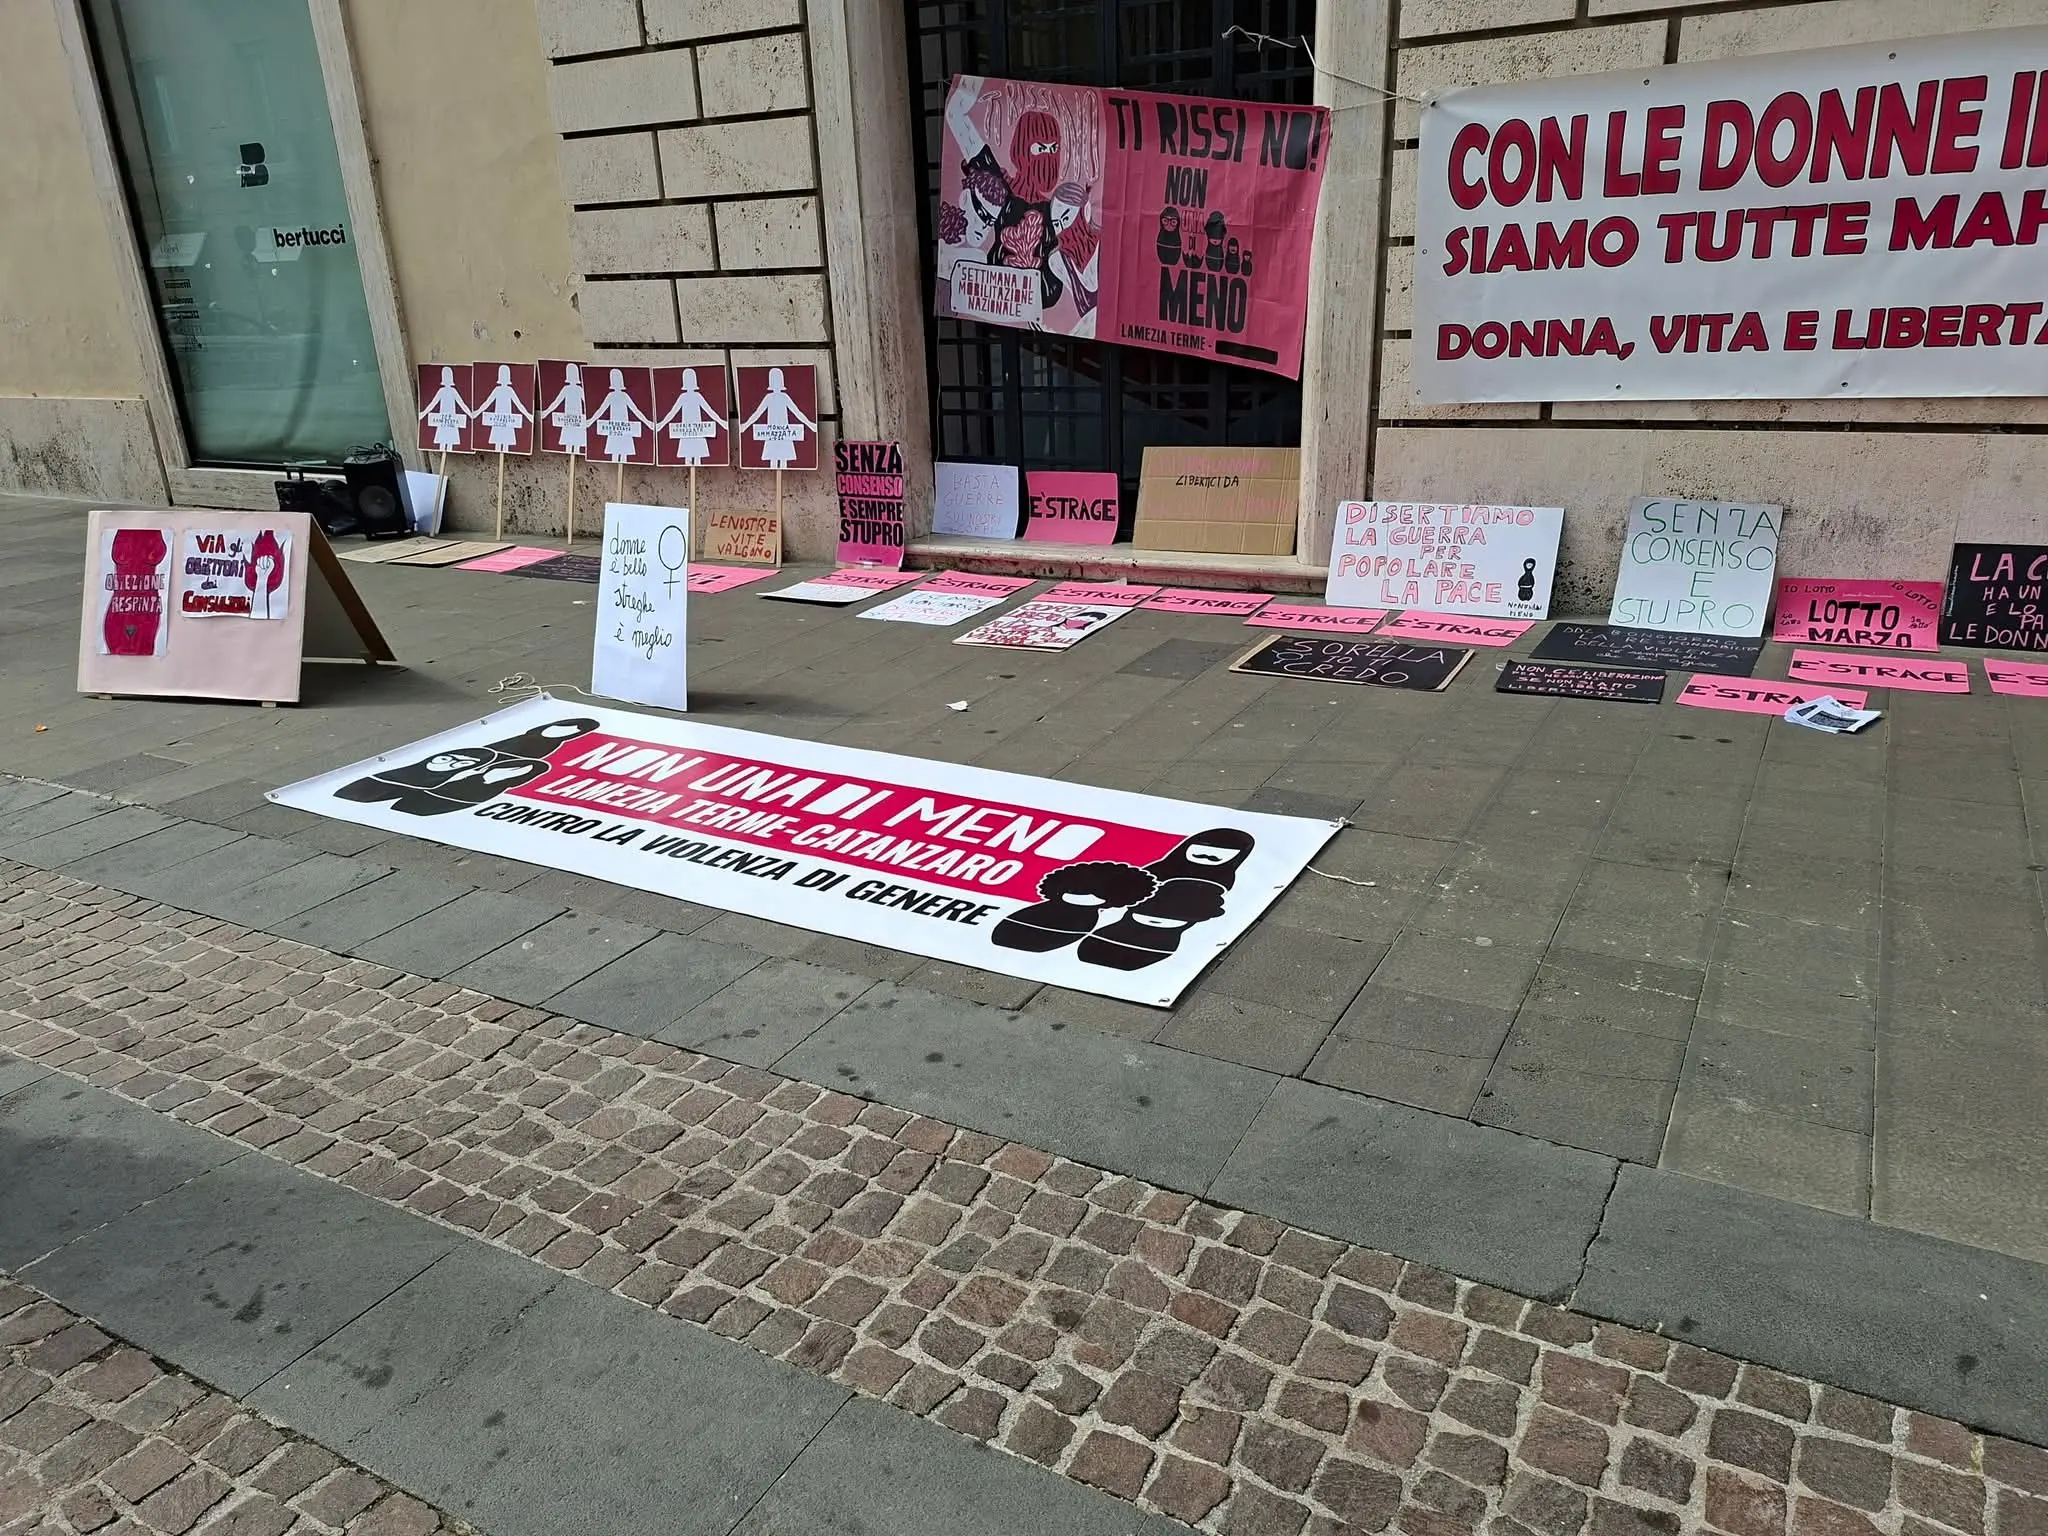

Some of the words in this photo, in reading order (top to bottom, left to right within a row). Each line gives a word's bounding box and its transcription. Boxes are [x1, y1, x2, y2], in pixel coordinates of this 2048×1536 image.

[1109, 98, 1143, 152] TI
[1157, 102, 1247, 163] RISSI
[1260, 110, 1327, 171] NO!
[1447, 114, 1588, 210] CON
[1603, 105, 1686, 198] LE
[1698, 75, 1988, 192] DONNE
[1165, 165, 1208, 209] NON
[1182, 210, 1205, 234] UNA
[273, 224, 346, 247] bertucci
[1442, 216, 1640, 277] SIAMO
[1656, 201, 1871, 264] TUTTE
[961, 266, 1017, 289] SETTIMANA
[1022, 275, 1033, 291] DI
[958, 281, 1034, 306] MOBILITAZIONE
[1160, 266, 1247, 334] MENO
[968, 296, 1021, 318] NAZIONALE
[1121, 323, 1167, 344] LAMEZIA
[1171, 331, 1206, 351] TERME
[1436, 315, 1635, 362] DONNA,
[1648, 311, 1770, 355] VITA
[1783, 310, 1819, 353] E
[1832, 302, 2048, 351] LIBERT
[834, 441, 903, 474] SENZA
[837, 474, 903, 498] CONSENSO
[952, 472, 1000, 490] BASTA
[848, 499, 903, 522] SEMPRE
[1345, 502, 1534, 526] DISERTIAMO
[1643, 502, 1780, 540] SENZA
[609, 521, 647, 556] donne
[731, 532, 766, 546] VITE
[840, 519, 903, 547] STUPRO
[1345, 527, 1377, 546] LA
[1389, 525, 1487, 546] GUERRA
[228, 537, 243, 558] gli
[1419, 544, 1462, 561] PER
[1631, 531, 1775, 571] CONSENSO
[1337, 554, 1476, 579] POPOLARE
[1970, 553, 2014, 582] LA
[1380, 580, 1418, 605] LA
[1434, 580, 1503, 605] PACE
[1690, 571, 1715, 598] E
[1784, 585, 1798, 593] IO
[1804, 585, 1836, 594] LOTTO
[1891, 581, 1904, 591] IO
[1905, 589, 1938, 611] LOTTO
[1983, 586, 2009, 601] HA
[2019, 585, 2041, 600] UN
[1616, 598, 1755, 631] STUPRO
[1808, 600, 1900, 630] LOTTO
[1986, 603, 1997, 616] E
[2008, 603, 2037, 616] LO
[1578, 633, 1607, 641] LA
[1808, 627, 1911, 648] MARZO
[1949, 622, 1978, 640] LE
[632, 628, 673, 661] meglio
[1291, 640, 1446, 666] SORELLA
[1574, 640, 1634, 649] DELLA
[1644, 646, 1739, 659] VIOLENZA
[1284, 661, 1409, 684] CREDO
[1370, 657, 1393, 666] TI
[1515, 664, 1546, 673] NON
[536, 774, 684, 816] LAMEZIA
[568, 741, 707, 784] NON
[688, 762, 828, 808] UNA
[800, 782, 895, 820] DI
[882, 796, 1106, 861] MENO
[473, 801, 596, 836] CONTRO
[599, 823, 640, 847] LA
[643, 834, 792, 883] VIOLENZA
[794, 867, 846, 892] DI
[845, 879, 1000, 926] GENERE
